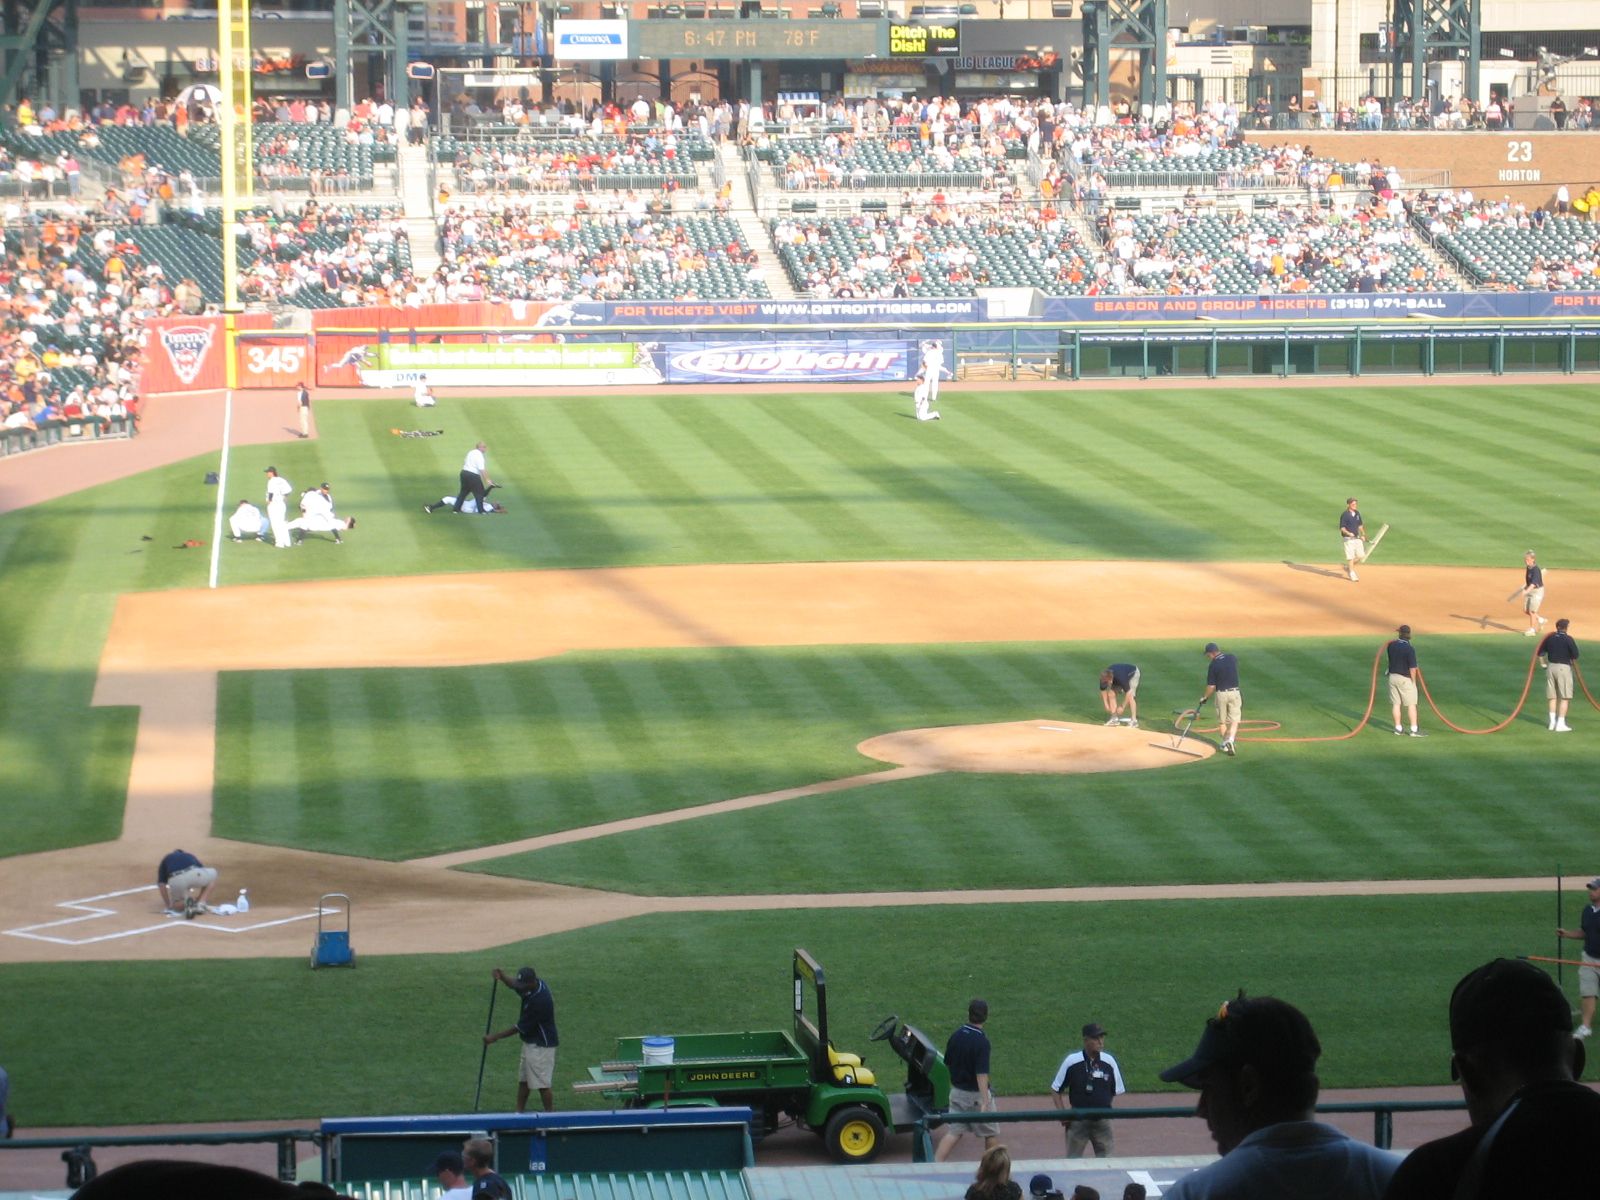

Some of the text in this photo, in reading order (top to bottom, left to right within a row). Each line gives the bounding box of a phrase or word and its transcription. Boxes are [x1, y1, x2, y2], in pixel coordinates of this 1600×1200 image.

[684, 30, 725, 46] 6:47
[735, 30, 757, 46] PM
[890, 25, 956, 39] Ditch The
[890, 39, 926, 52] Dish!
[954, 57, 973, 70] BIG
[976, 57, 1015, 70] LEAGUE
[1507, 141, 1533, 162] 23
[1498, 169, 1541, 182] HORTON
[1094, 298, 1446, 312] SEASON AND GROUP TICKETS (313) 471-BALL
[1554, 296, 1585, 306] FOR
[614, 302, 972, 317] FOR TICKETS VISIT WWW.DETROITTIGERS.COM
[701, 351, 900, 371] BUD LIGHT
